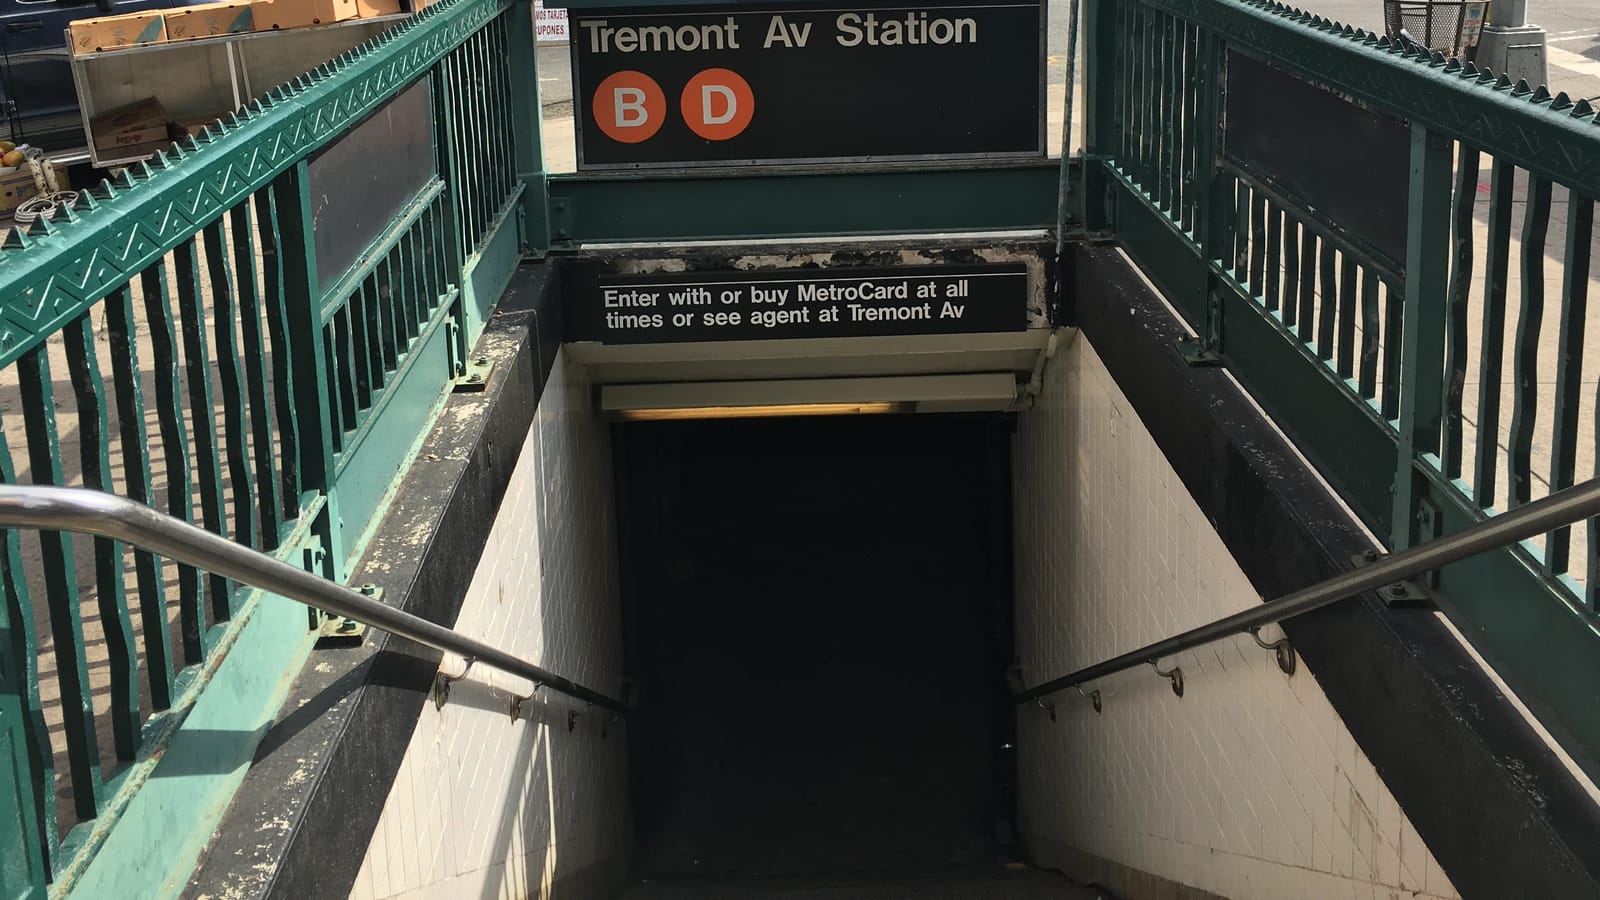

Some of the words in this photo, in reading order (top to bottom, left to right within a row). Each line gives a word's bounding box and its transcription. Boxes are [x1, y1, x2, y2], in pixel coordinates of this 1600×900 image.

[536, 25, 564, 35] UPONES
[581, 17, 740, 53] Tremont
[764, 16, 813, 48] Av
[836, 12, 977, 47] Station
[614, 87, 649, 127] B
[701, 84, 737, 125] D
[604, 289, 660, 308] Enter
[668, 287, 712, 306] with
[720, 290, 743, 305] or
[750, 285, 789, 306] buy
[797, 281, 908, 302] MetroCard
[916, 281, 937, 299] at
[945, 279, 969, 298] all
[605, 312, 664, 329] times
[672, 313, 695, 327] or
[703, 311, 742, 326] see
[750, 306, 810, 328] agent
[818, 305, 839, 323] at
[846, 302, 931, 322] Tremont
[939, 301, 965, 319] Av
